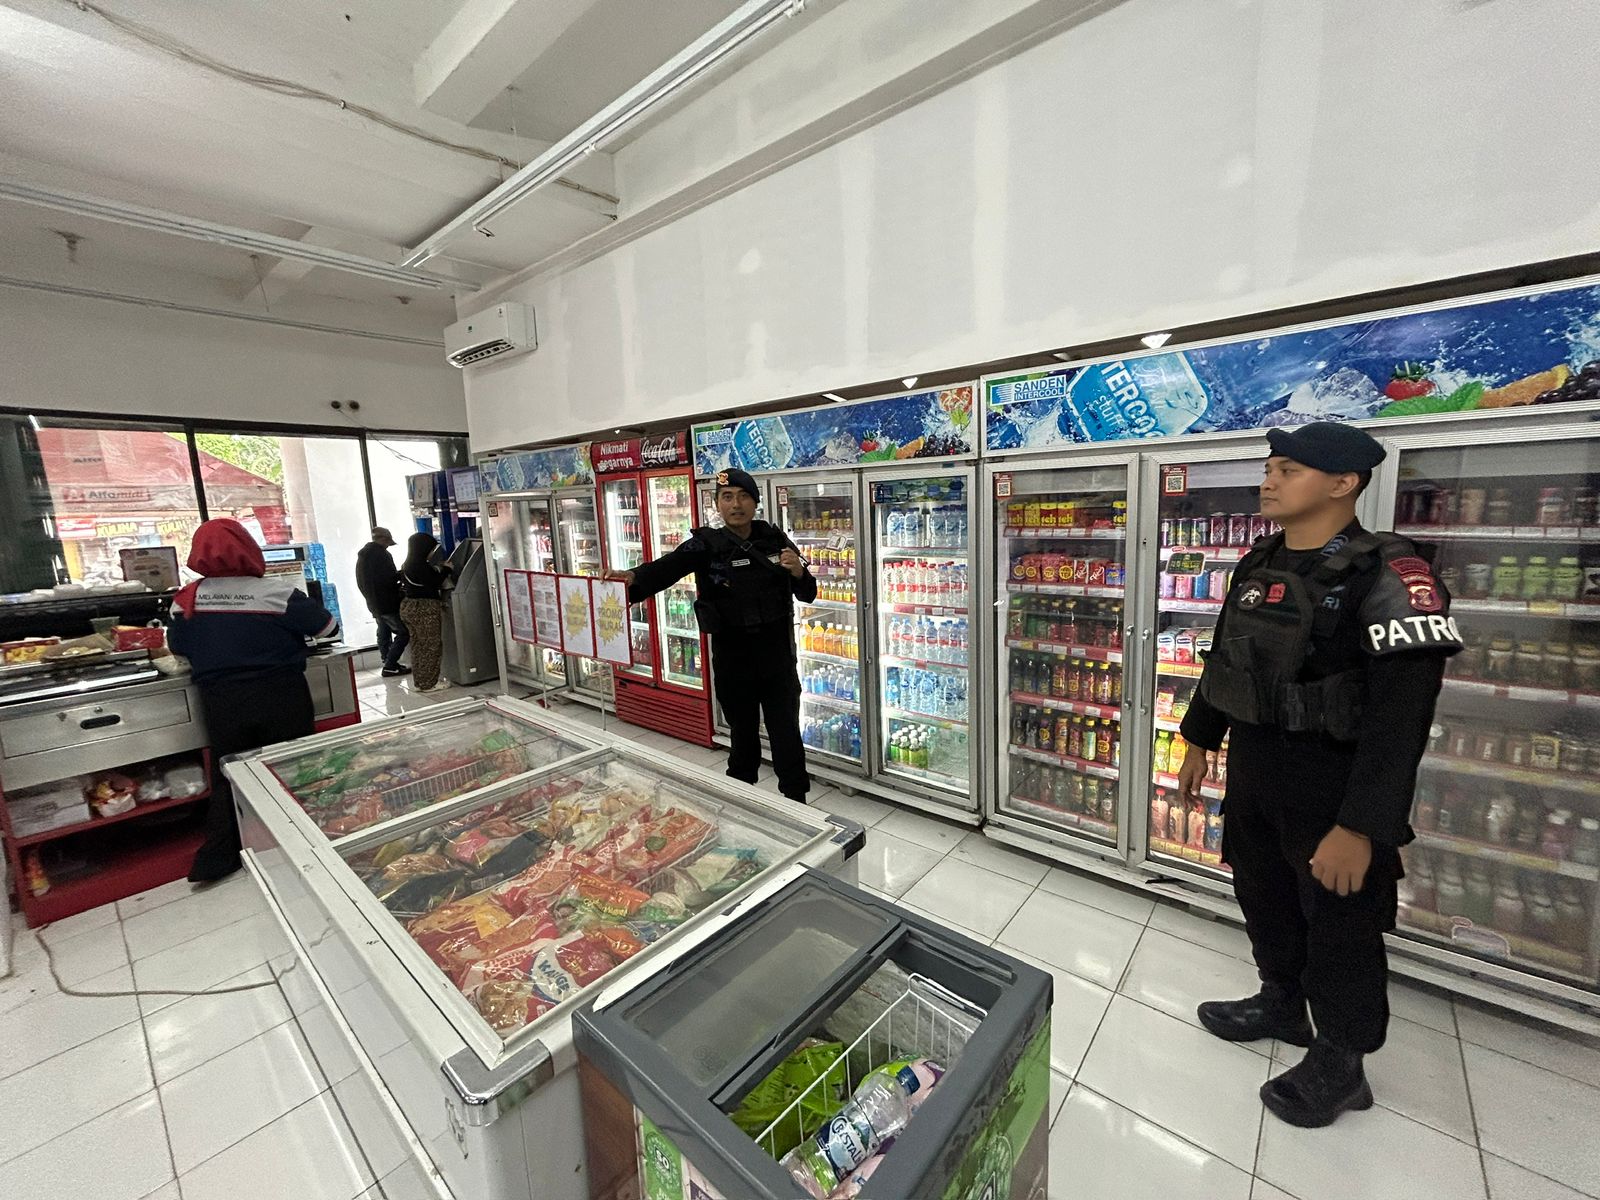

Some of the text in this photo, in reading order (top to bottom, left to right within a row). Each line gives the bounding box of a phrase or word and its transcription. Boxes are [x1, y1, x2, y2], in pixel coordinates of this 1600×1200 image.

[1014, 377, 1065, 393] SANDEN
[1014, 387, 1064, 401] INTERCOOL
[600, 440, 629, 455] Nikmati
[641, 436, 677, 464] Coca-Cola
